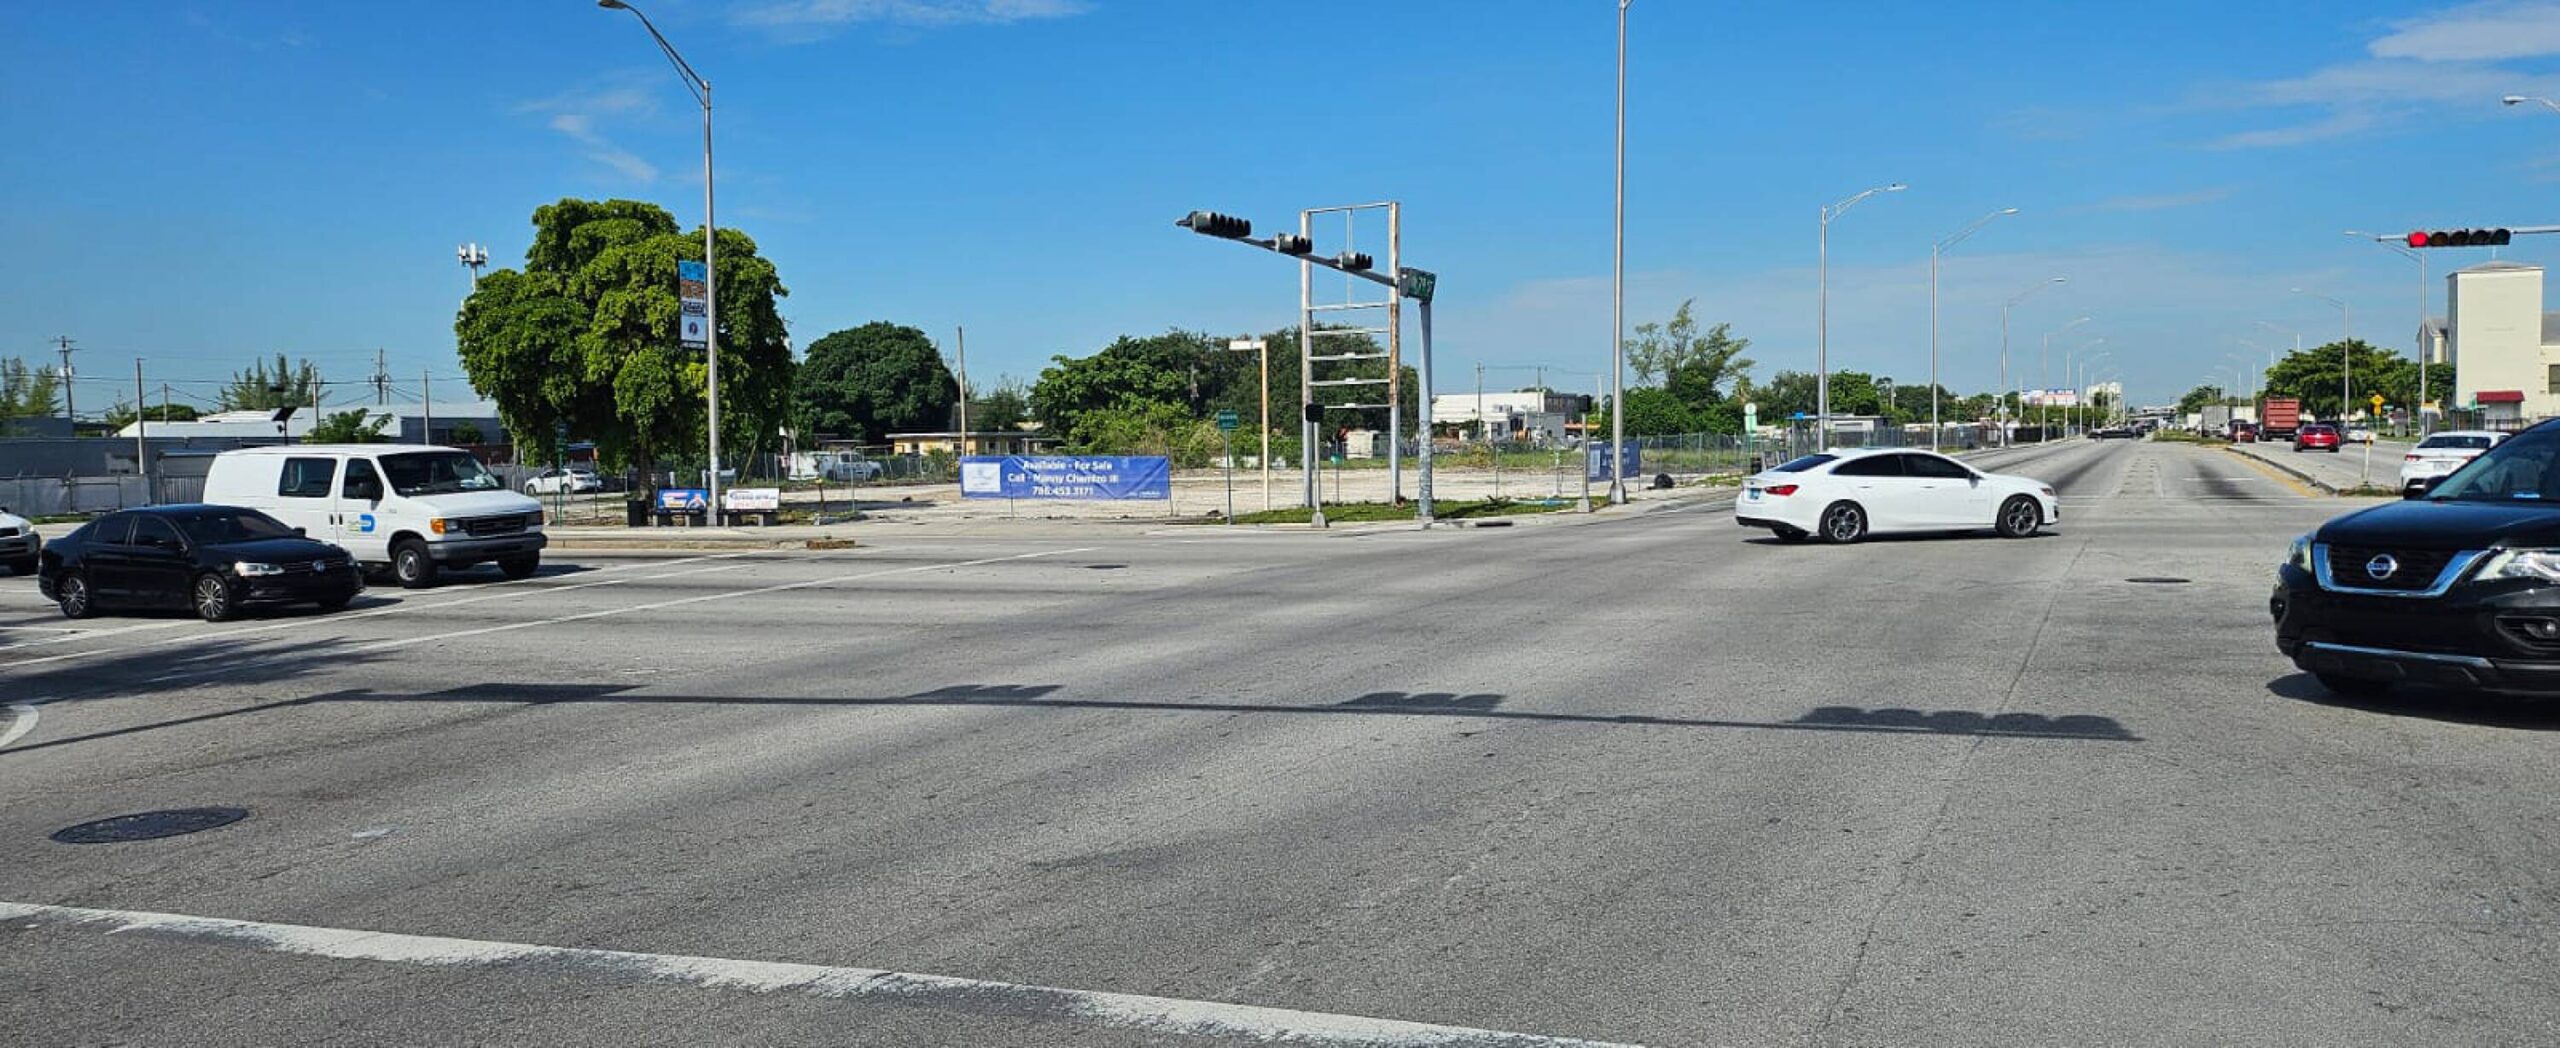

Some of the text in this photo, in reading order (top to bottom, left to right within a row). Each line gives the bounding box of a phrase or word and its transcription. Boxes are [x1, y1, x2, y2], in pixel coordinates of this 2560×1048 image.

[1024, 461, 1066, 470] Available
[1074, 461, 1090, 470] For
[1092, 461, 1112, 470] Sale
[1008, 473, 1025, 482] Call
